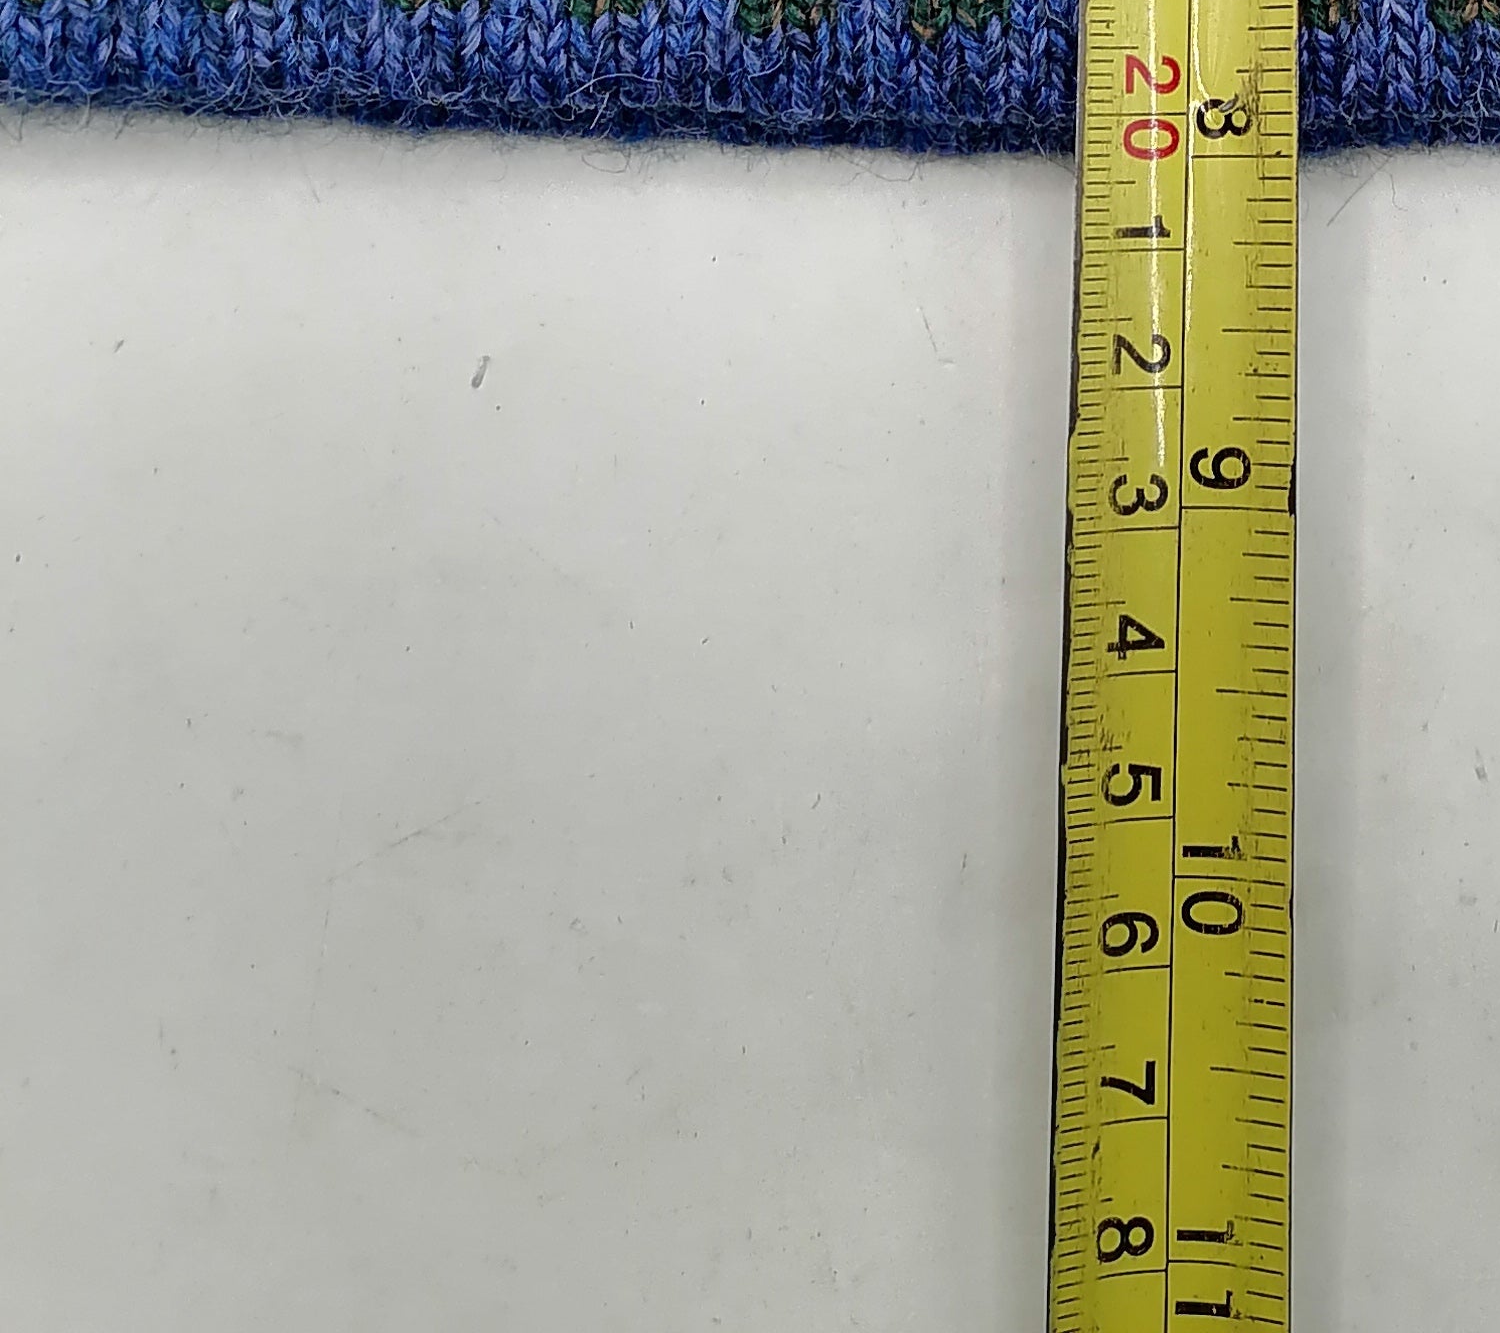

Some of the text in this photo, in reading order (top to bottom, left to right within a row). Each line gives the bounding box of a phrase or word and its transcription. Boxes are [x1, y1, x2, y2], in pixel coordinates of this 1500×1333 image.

[1123, 54, 1181, 161] 20
[1197, 98, 1251, 139] 8
[1112, 215, 1171, 239] 1
[1112, 333, 1171, 375] 2
[1189, 446, 1251, 490] 9
[1109, 474, 1169, 516] 3
[1107, 614, 1165, 660] 4
[1101, 763, 1162, 807] 5
[1182, 835, 1248, 935] 10
[1100, 911, 1159, 957] 6
[1100, 1060, 1156, 1106] 7
[1096, 1217, 1154, 1264] 8
[1175, 1219, 1243, 1318] 11
